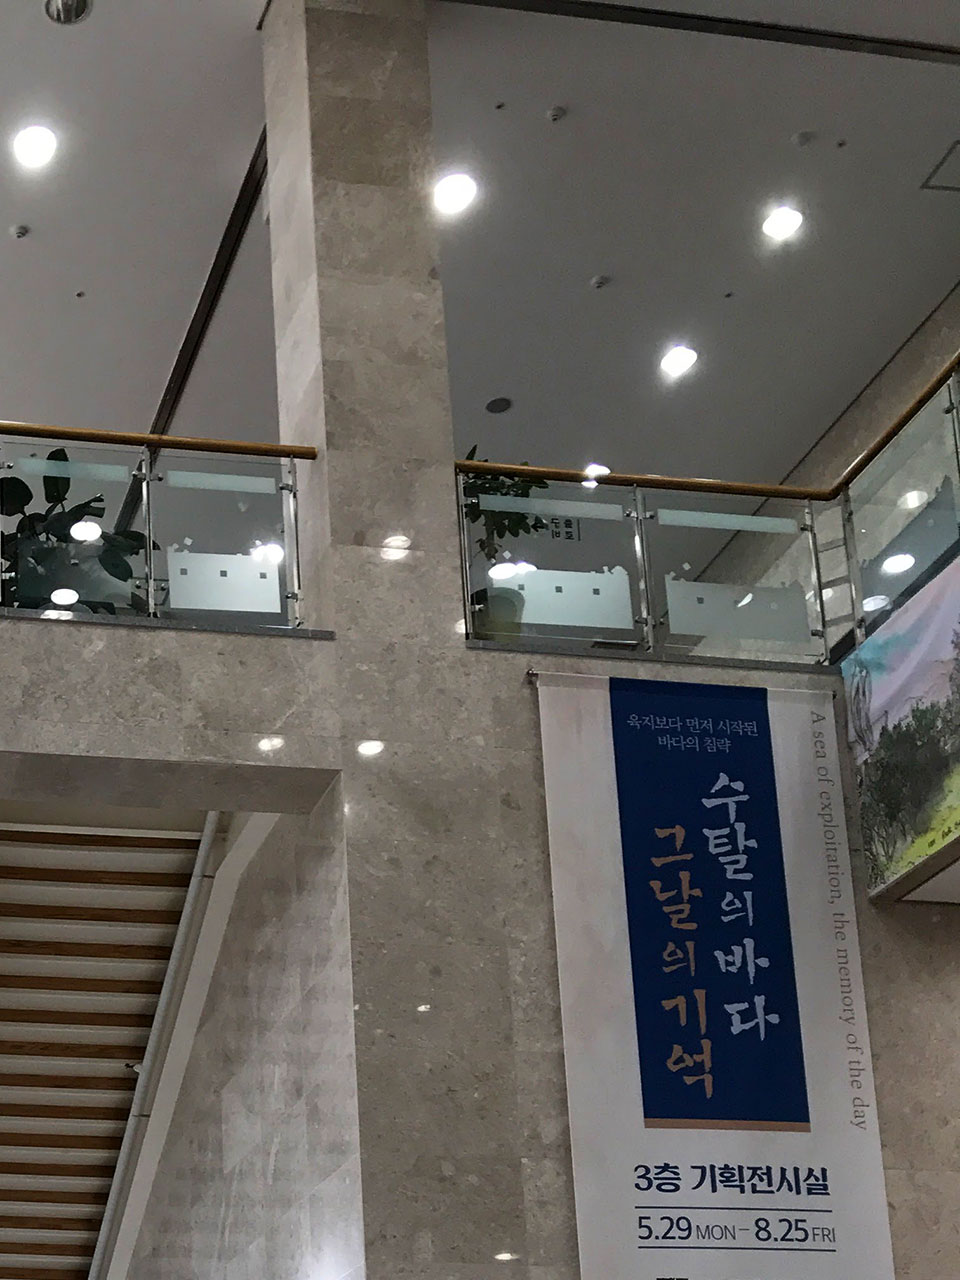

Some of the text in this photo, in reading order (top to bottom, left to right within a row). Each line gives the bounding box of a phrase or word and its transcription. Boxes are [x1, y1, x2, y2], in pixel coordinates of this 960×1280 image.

[627, 713, 759, 736] 육지보다 먼저 시작된
[811, 711, 826, 724] A
[658, 734, 732, 753] 바다의 침략
[813, 732, 827, 759] sea
[817, 767, 835, 787] of
[701, 772, 780, 1041] 수탈의 바다
[832, 912, 850, 941] the
[837, 948, 856, 1026] memory
[661, 988, 714, 1100] 기억
[847, 1033, 864, 1055] of
[849, 1060, 866, 1089] the
[850, 1097, 870, 1131] day
[634, 1162, 831, 1196] 3층 기획전시실
[638, 1215, 692, 1241] 5.29
[696, 1224, 737, 1241] MON
[754, 1217, 809, 1243] 8.25
[812, 1226, 836, 1243] FRI
